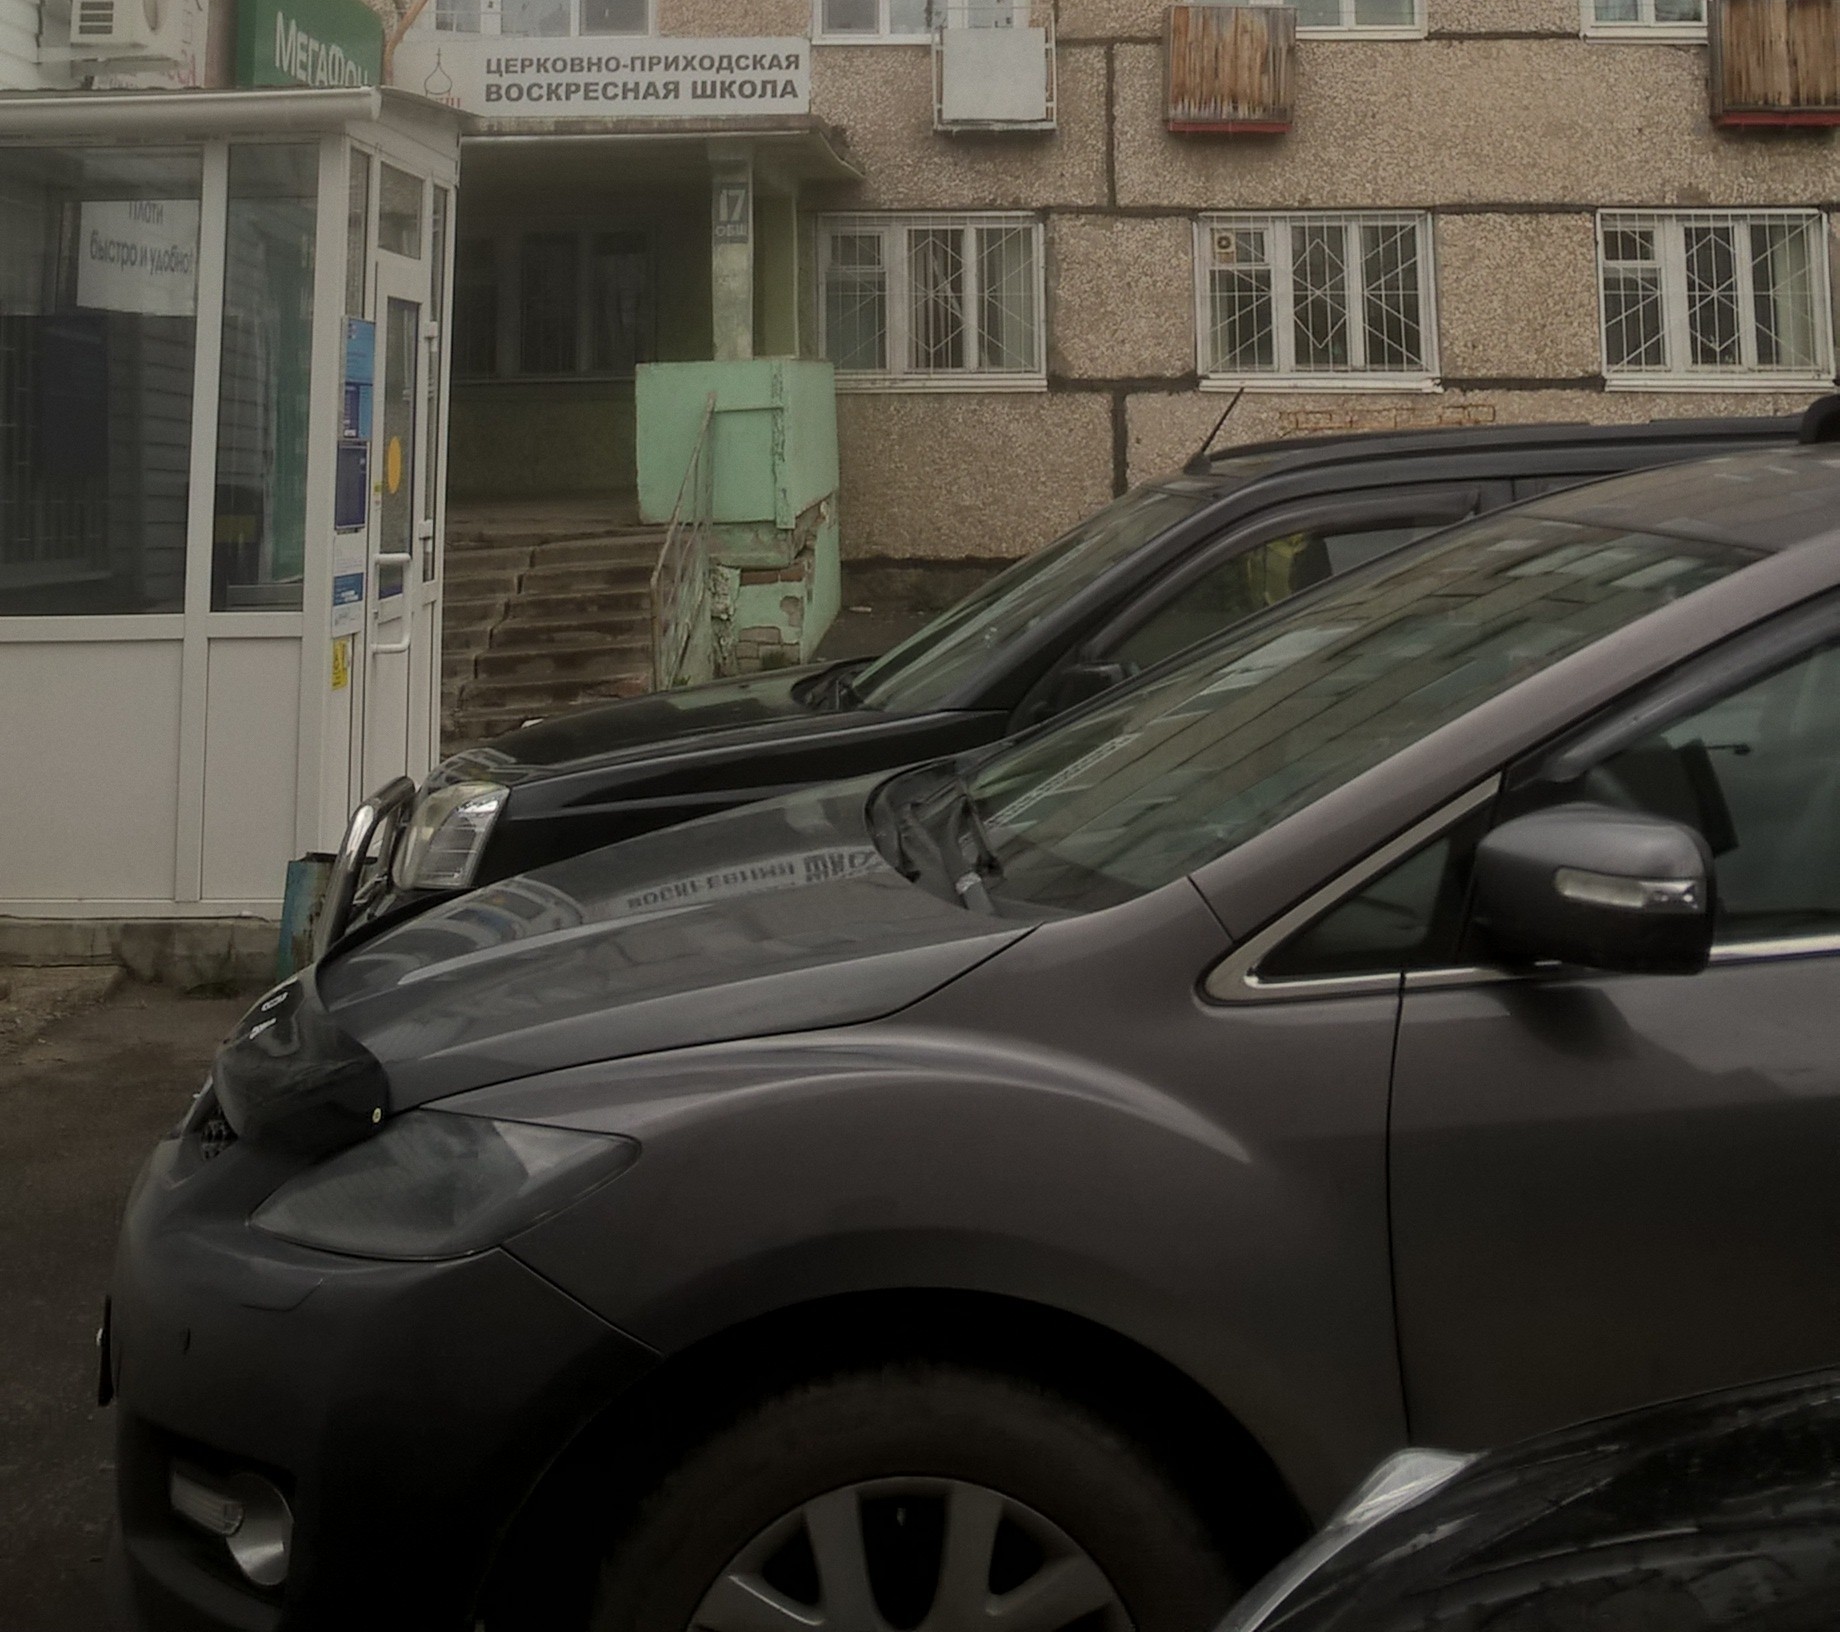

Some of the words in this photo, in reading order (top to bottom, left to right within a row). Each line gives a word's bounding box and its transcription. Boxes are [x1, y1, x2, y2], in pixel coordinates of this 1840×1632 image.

[485, 53, 800, 77] ЦЕРКОВНО-ПРИХОДСКАЯ
[484, 80, 680, 103] ВОСКРЕСНАЯ
[690, 79, 799, 100] ШКОЛА
[719, 189, 746, 222] 17
[89, 229, 138, 272] быстро
